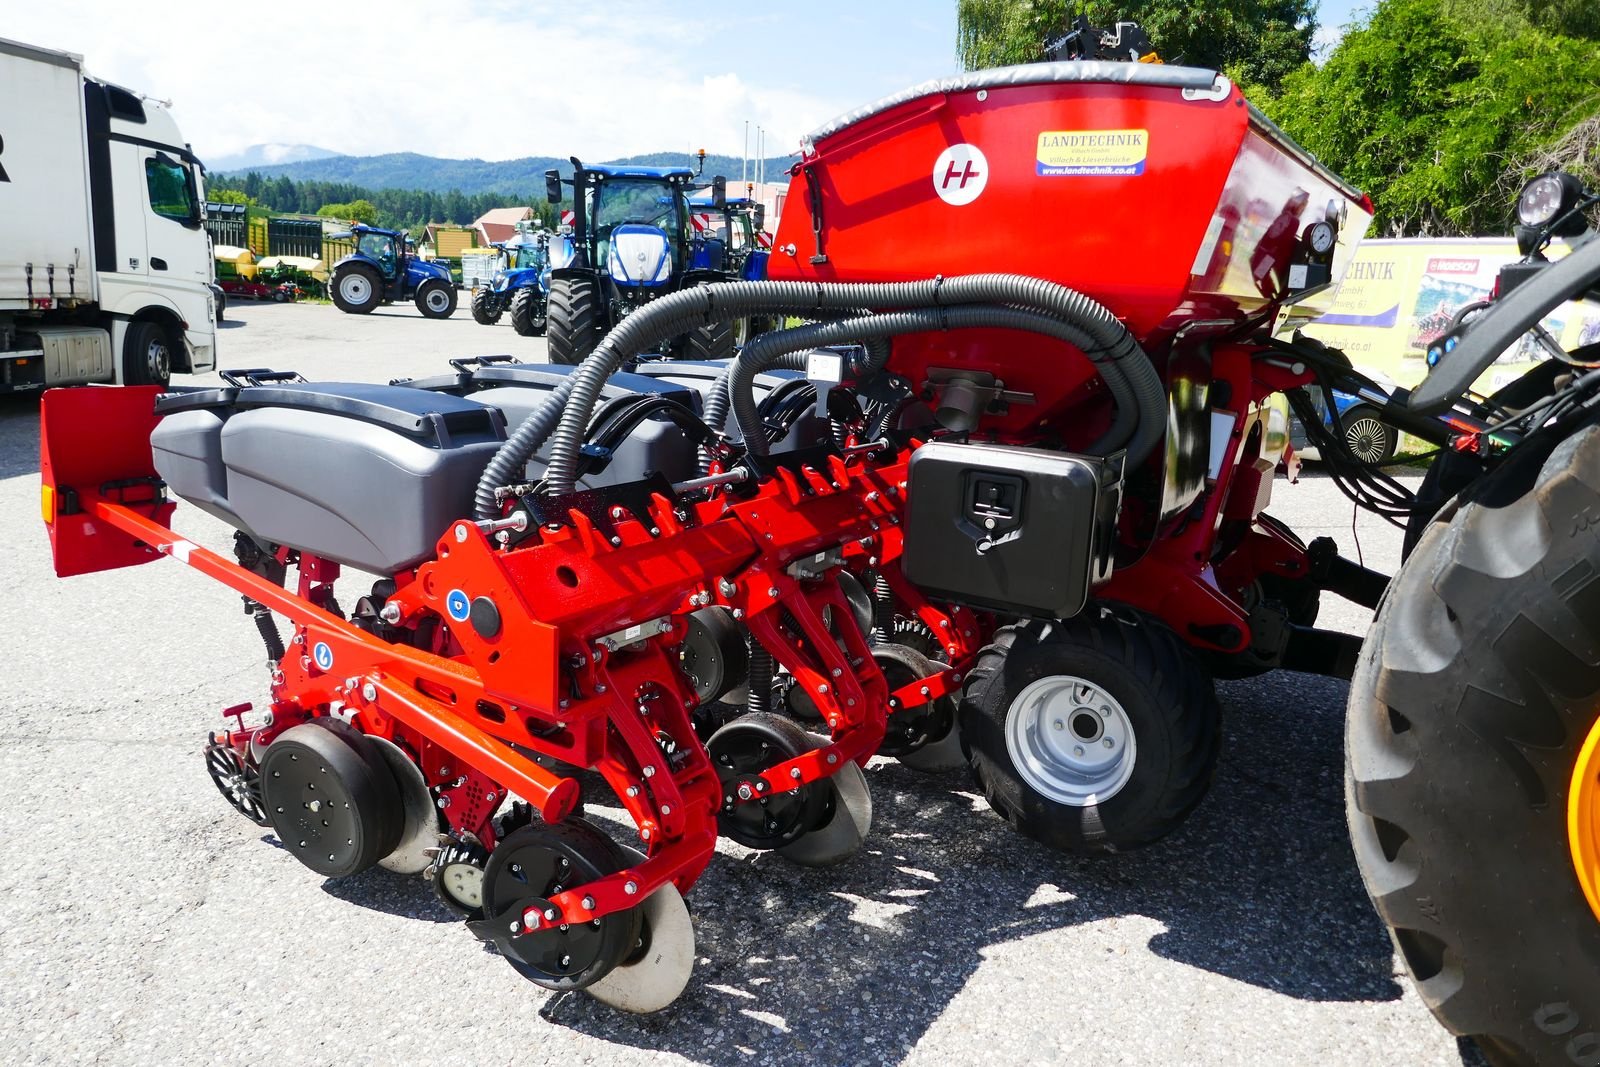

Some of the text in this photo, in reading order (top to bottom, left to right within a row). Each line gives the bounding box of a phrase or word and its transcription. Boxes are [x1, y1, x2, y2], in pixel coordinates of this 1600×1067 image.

[1042, 134, 1142, 147] LANDTECHNIK
[1042, 166, 1137, 175] www.landtechnik.co.at
[1437, 261, 1477, 272] HORSCH
